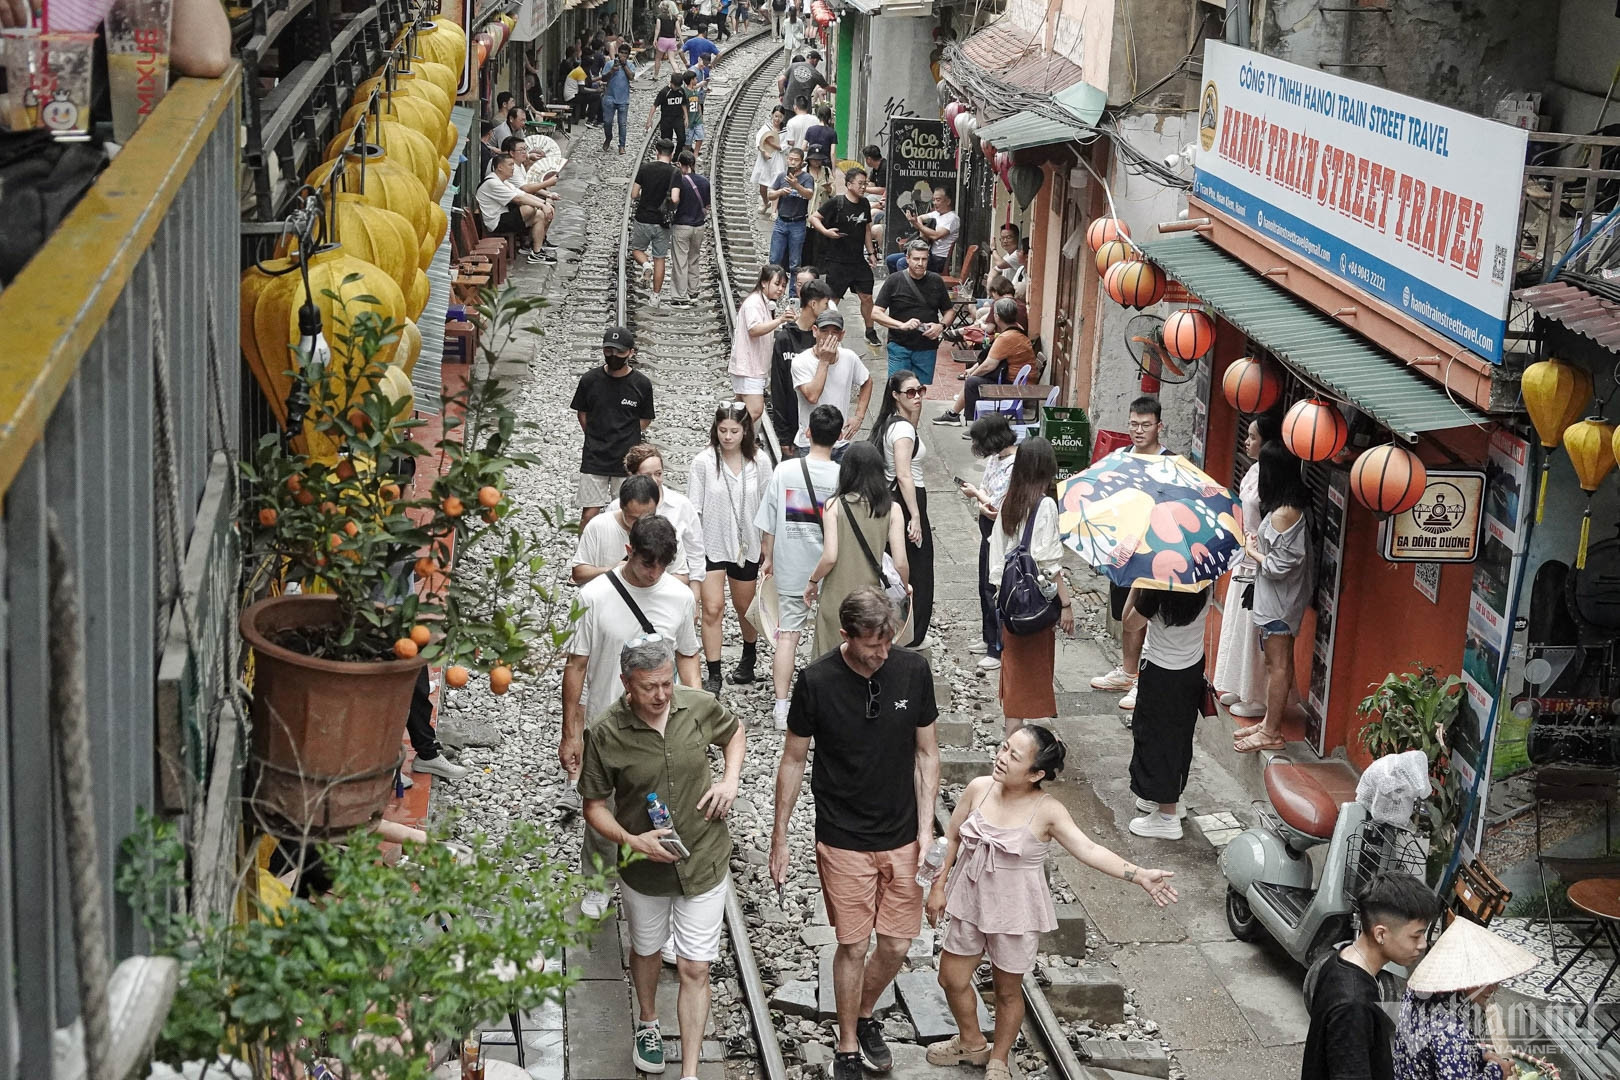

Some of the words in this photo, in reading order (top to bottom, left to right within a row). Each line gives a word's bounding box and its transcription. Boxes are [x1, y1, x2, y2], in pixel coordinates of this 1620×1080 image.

[135, 28, 158, 115] MIXUE
[1239, 60, 1265, 94] CÔNG
[1266, 72, 1277, 97] TY
[1278, 76, 1303, 106] TNHH
[1303, 84, 1336, 118] HANOI
[1337, 94, 1368, 128] TRAIN
[1368, 104, 1406, 141] STREET
[1407, 116, 1449, 157] TRAVEL
[911, 128, 939, 146] Ice
[901, 139, 950, 160] Cream
[900, 169, 928, 177] DELICIOUS
[1317, 144, 1396, 235] STREET
[1395, 173, 1484, 279] TRAVEL
[1347, 262, 1358, 276] +84
[1357, 266, 1371, 283] 9043
[1410, 293, 1494, 352] hanoitrainstreettravel.com
[1051, 439, 1083, 447] SAIGON
[1397, 536, 1408, 547] GA
[1412, 534, 1437, 548] ĐÔNG
[1439, 535, 1470, 548] DƯƠNG
